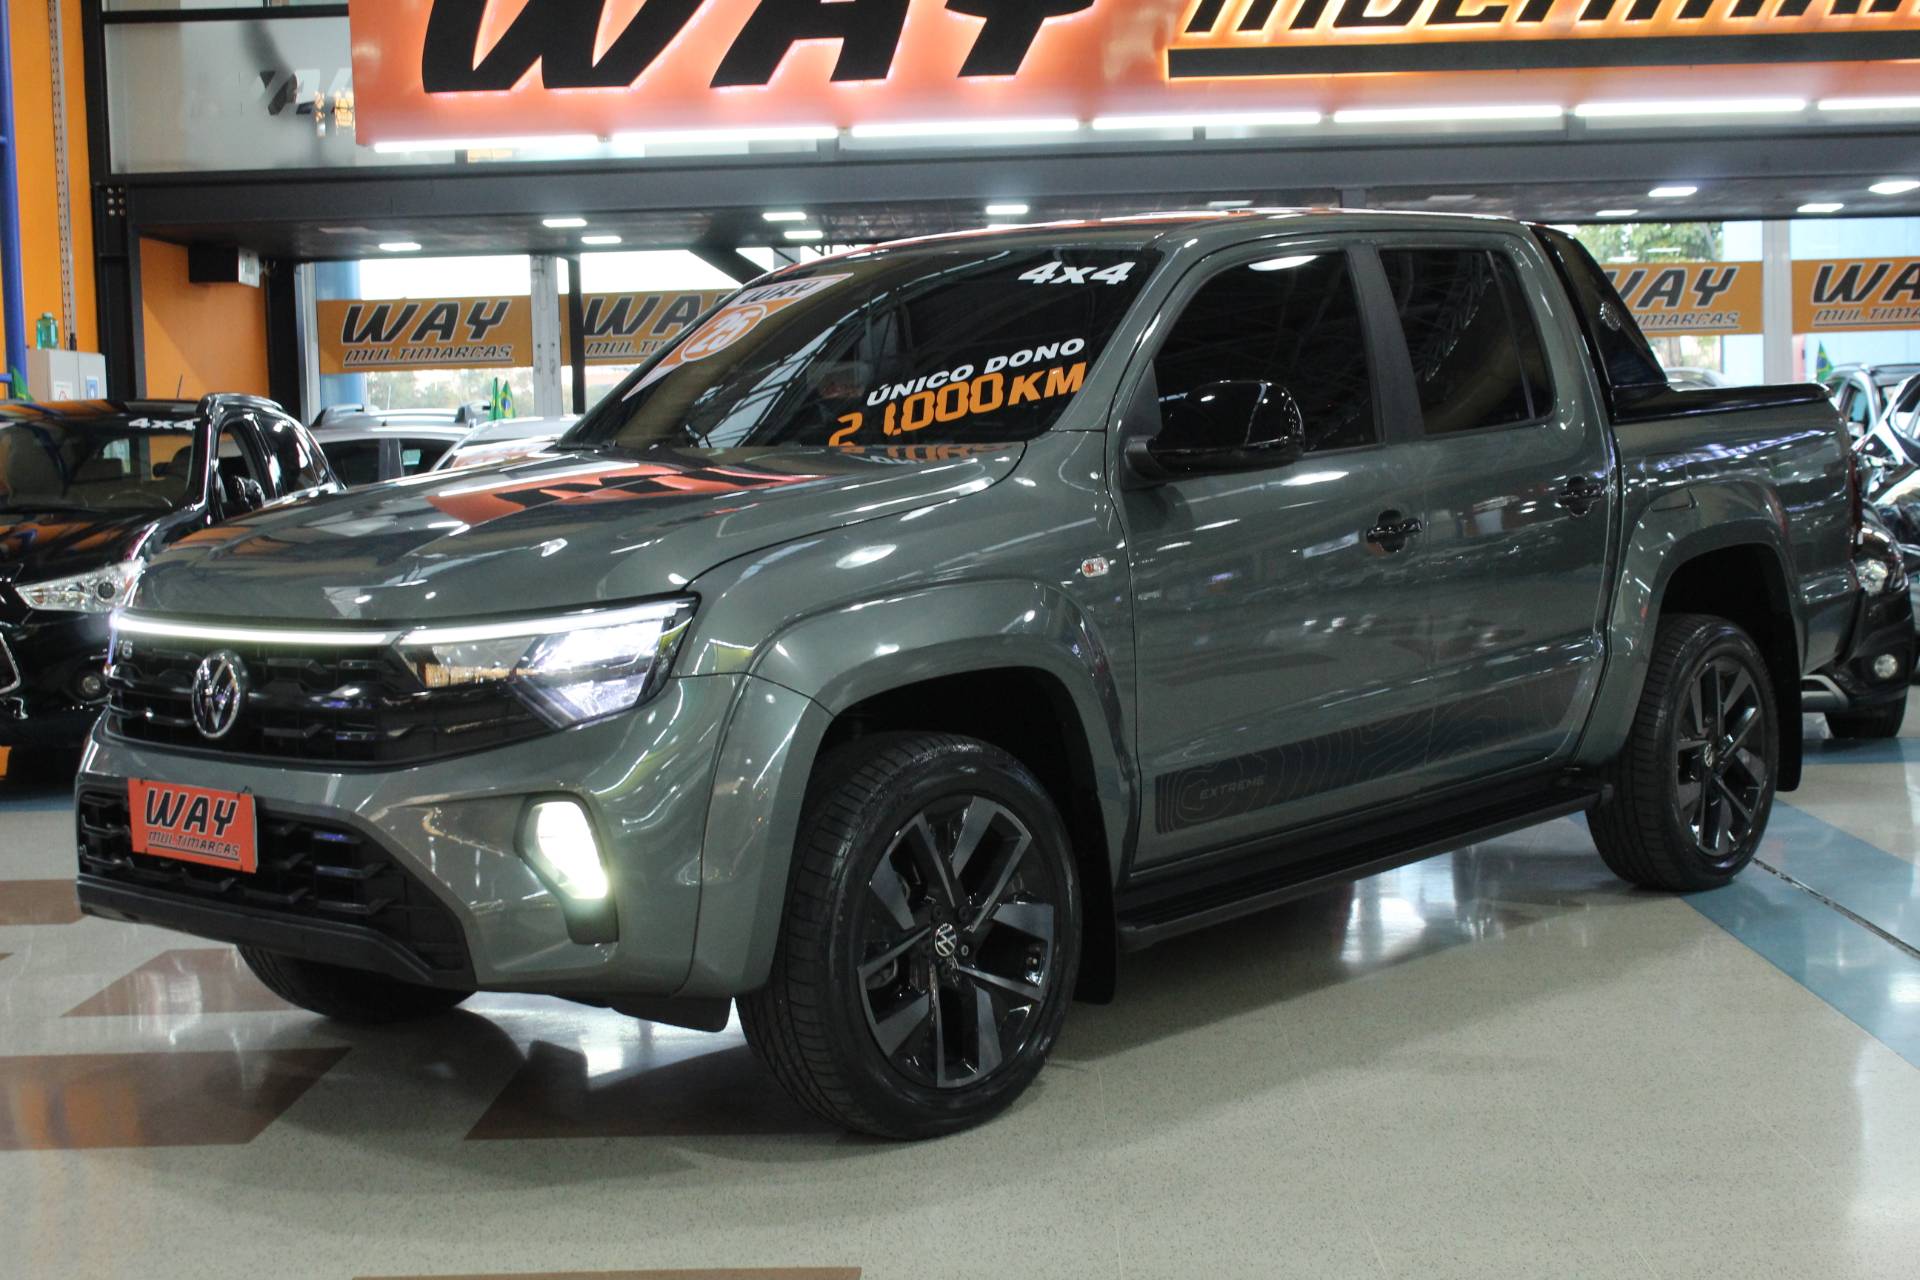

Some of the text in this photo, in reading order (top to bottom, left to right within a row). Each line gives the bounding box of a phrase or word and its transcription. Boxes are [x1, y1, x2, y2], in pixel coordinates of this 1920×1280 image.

[422, 0, 1095, 93] WAY
[1018, 261, 1136, 285] 4x4
[1811, 262, 1920, 305] WA
[342, 300, 511, 344] WAY
[584, 295, 728, 337] WA
[1814, 307, 1920, 322] MULTIM
[345, 345, 513, 363] MULTIMARCAS
[867, 338, 1085, 407] ÚNICO DONO
[128, 417, 200, 431] 4x4
[1200, 776, 1265, 800] EXTREME
[145, 787, 239, 838] WAY
[147, 830, 241, 857] MULTIMARCAS
